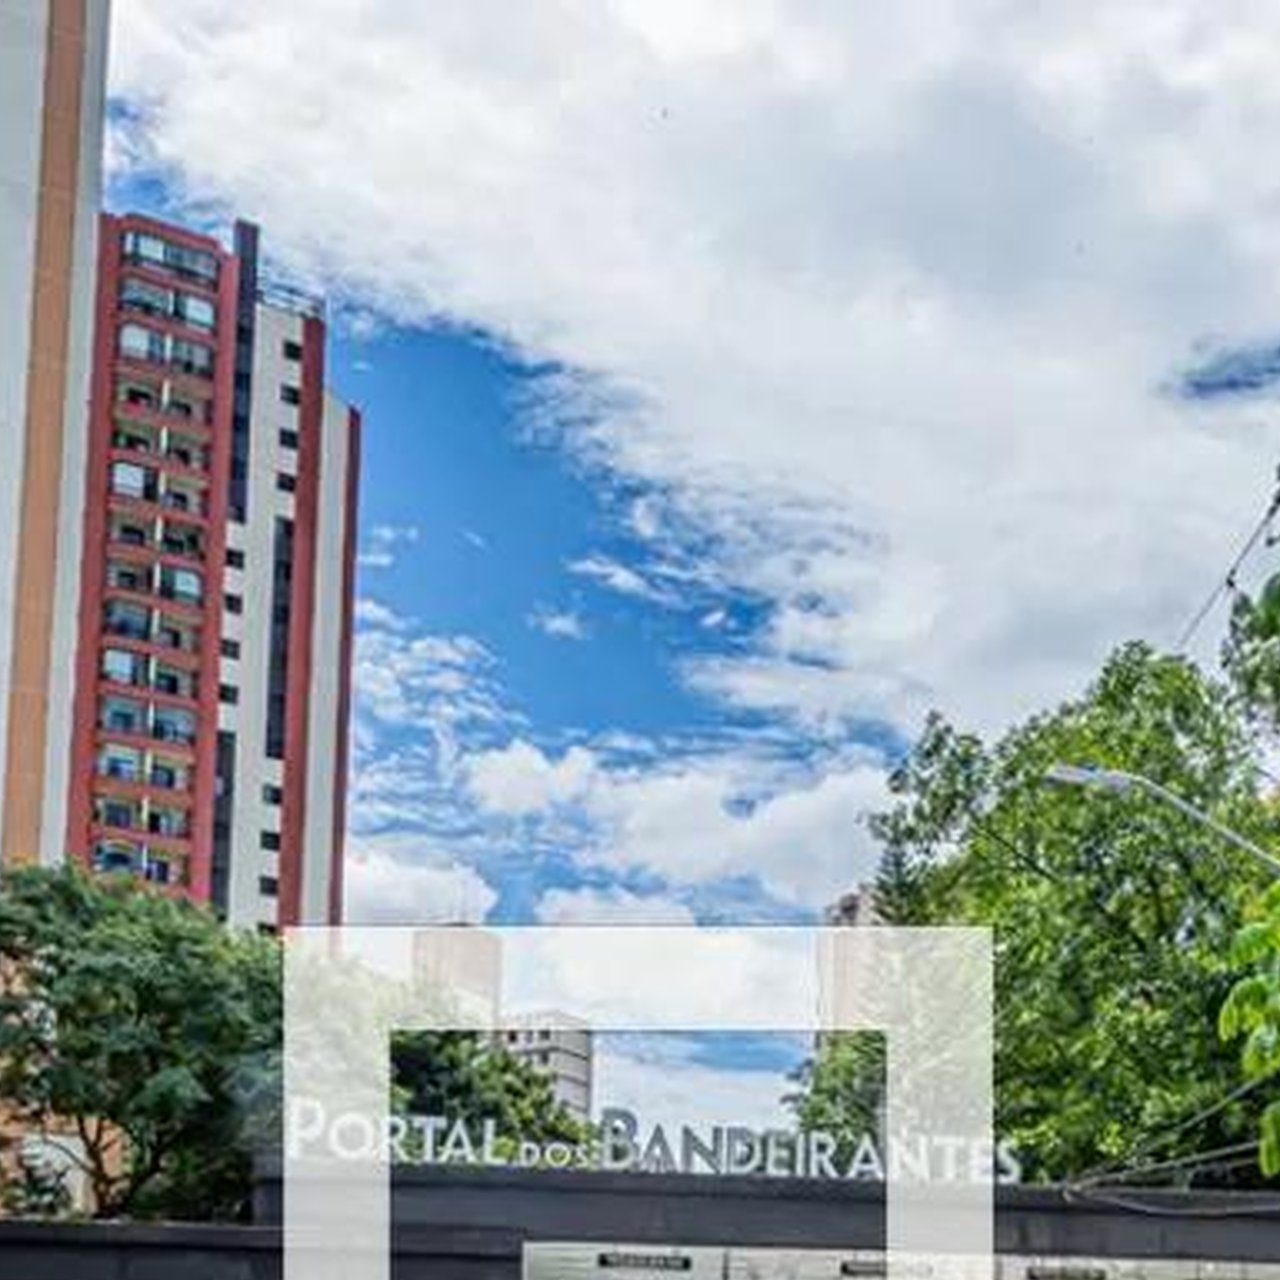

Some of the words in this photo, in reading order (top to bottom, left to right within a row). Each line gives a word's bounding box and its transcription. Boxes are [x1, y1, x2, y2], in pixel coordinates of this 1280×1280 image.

[287, 1097, 507, 1165] PORTAL
[520, 1141, 590, 1169] DOS
[601, 1107, 1021, 1185] BANDEIRANTES
